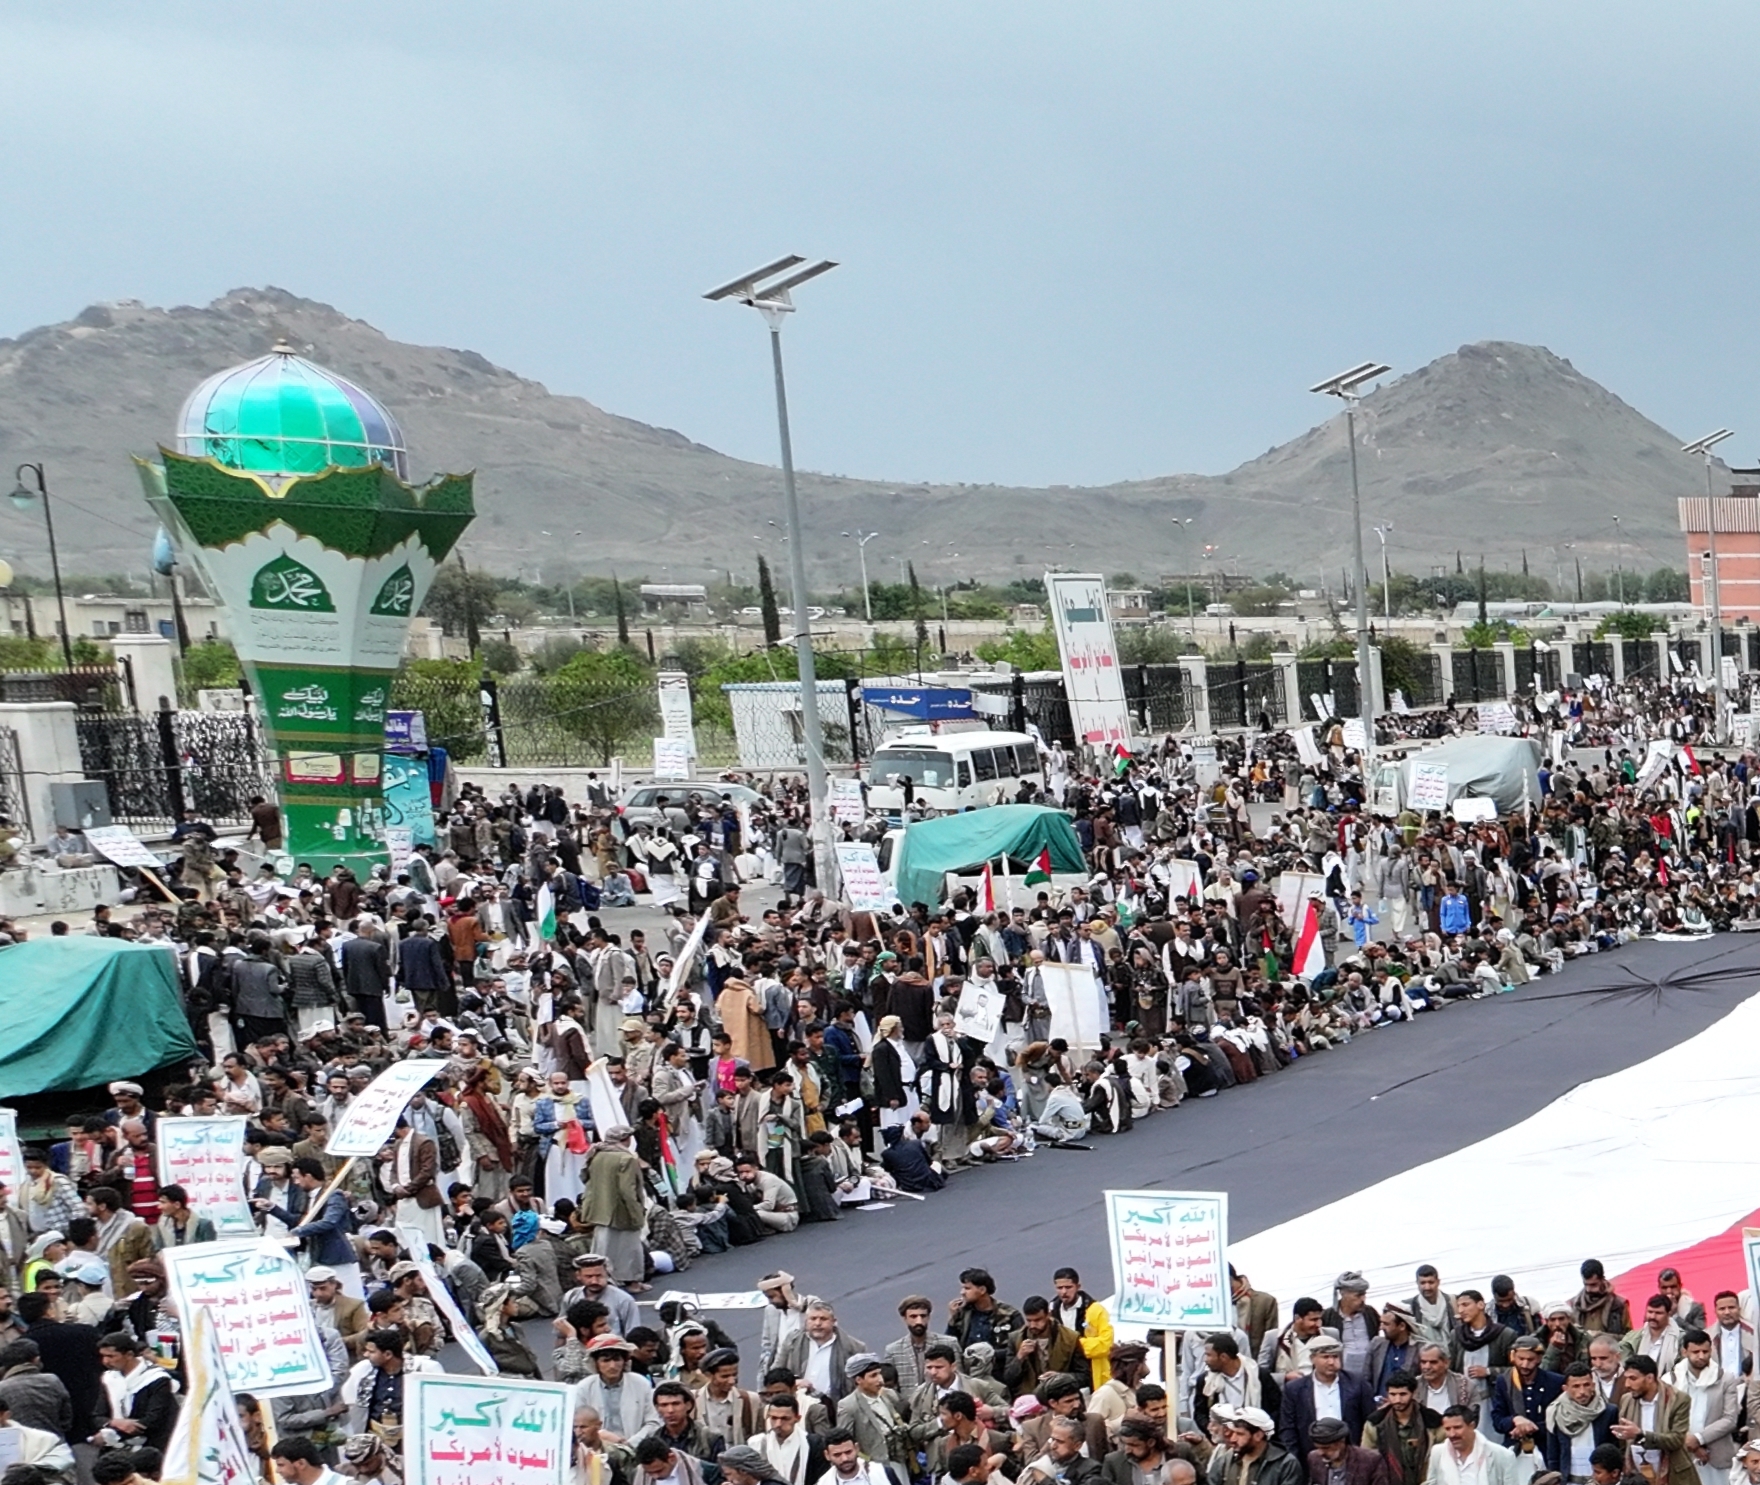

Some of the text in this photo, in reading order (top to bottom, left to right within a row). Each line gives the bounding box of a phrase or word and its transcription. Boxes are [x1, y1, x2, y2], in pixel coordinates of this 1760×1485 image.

[429, 1392, 557, 1435] الله أكبر
[507, 1448, 555, 1470] الموت
